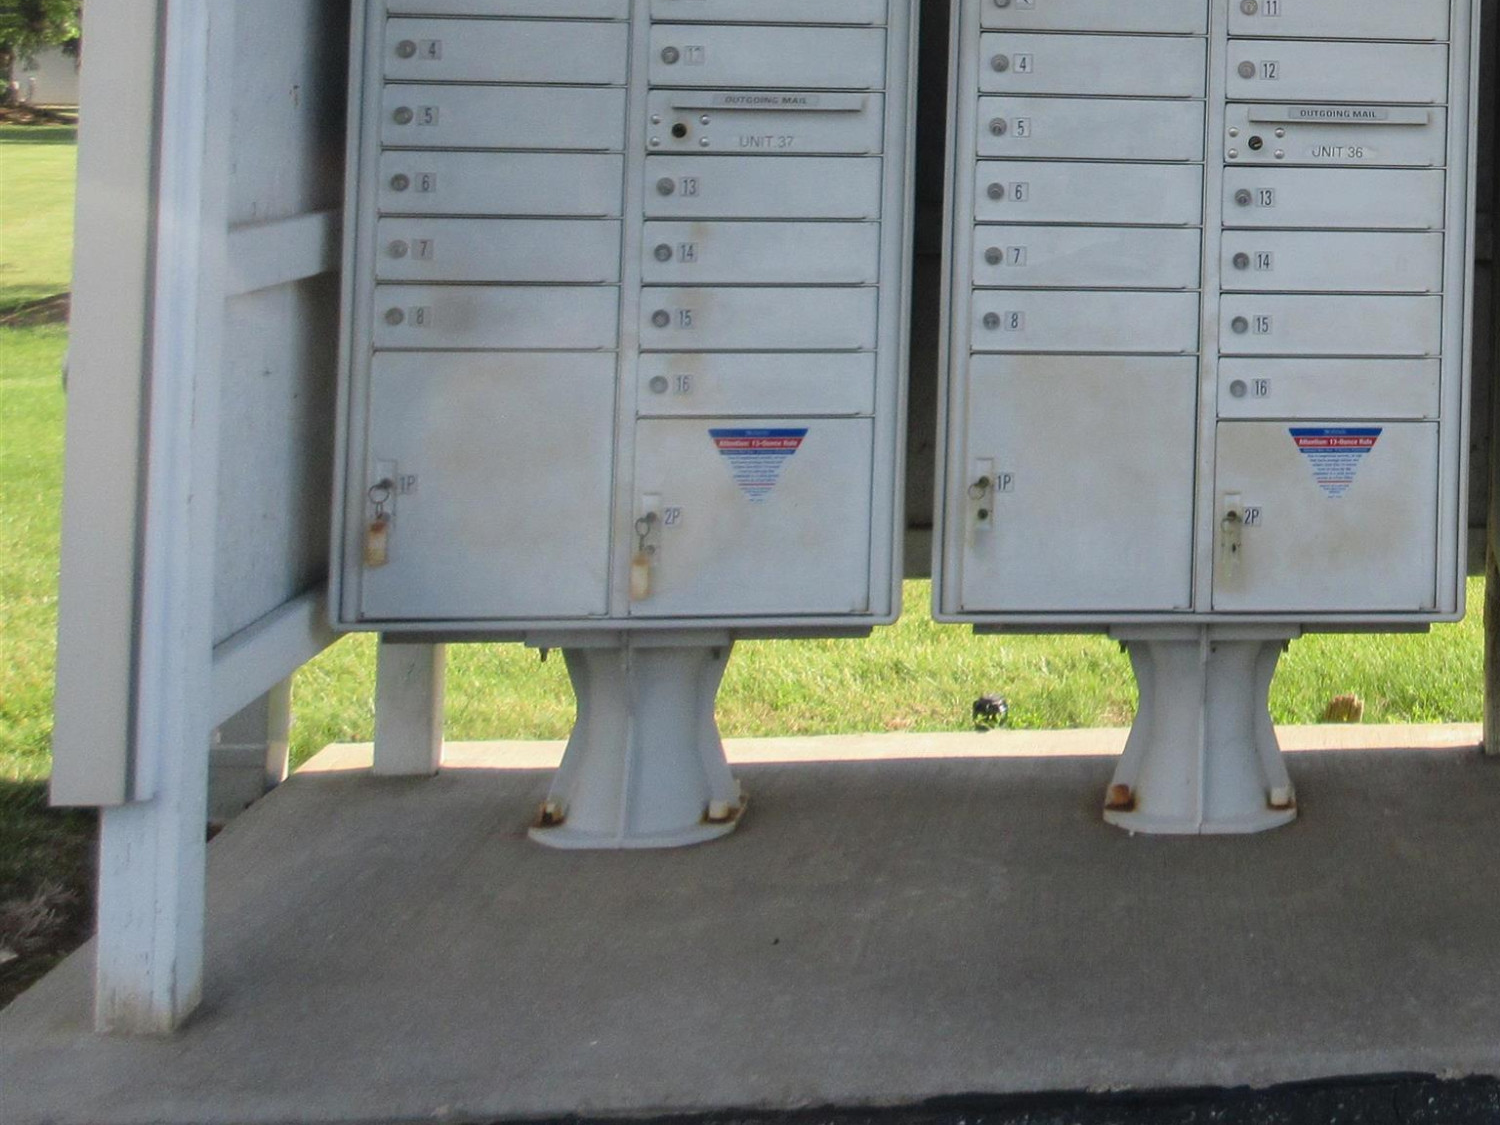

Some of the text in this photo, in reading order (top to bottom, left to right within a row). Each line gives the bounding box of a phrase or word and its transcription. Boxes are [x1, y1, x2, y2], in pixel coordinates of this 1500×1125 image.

[1266, 0, 1278, 16] 11
[428, 42, 437, 59] 4
[1018, 56, 1027, 71] 4
[1263, 62, 1276, 79] 12
[424, 107, 433, 124] 5
[1299, 109, 1378, 119] OUTGOING MAIL
[1016, 120, 1025, 136] 5
[738, 135, 795, 149] UNIT 37
[1347, 146, 1364, 159] 36
[421, 174, 430, 192] 6
[682, 179, 697, 195] 13
[1014, 184, 1022, 201] 6
[1259, 190, 1272, 206] 13
[419, 240, 428, 257] 7
[679, 244, 694, 260] 14
[1013, 247, 1021, 264] 7
[1257, 254, 1270, 269] 14
[416, 307, 425, 325] 8
[678, 309, 692, 326] 15
[1010, 312, 1019, 329] 8
[1256, 317, 1269, 333] 15
[677, 375, 690, 392] 16
[1255, 380, 1268, 396] 16
[400, 475, 416, 491] 1P
[996, 474, 1012, 491] 1P
[664, 508, 681, 525] 2P
[1244, 508, 1259, 525] 2P
